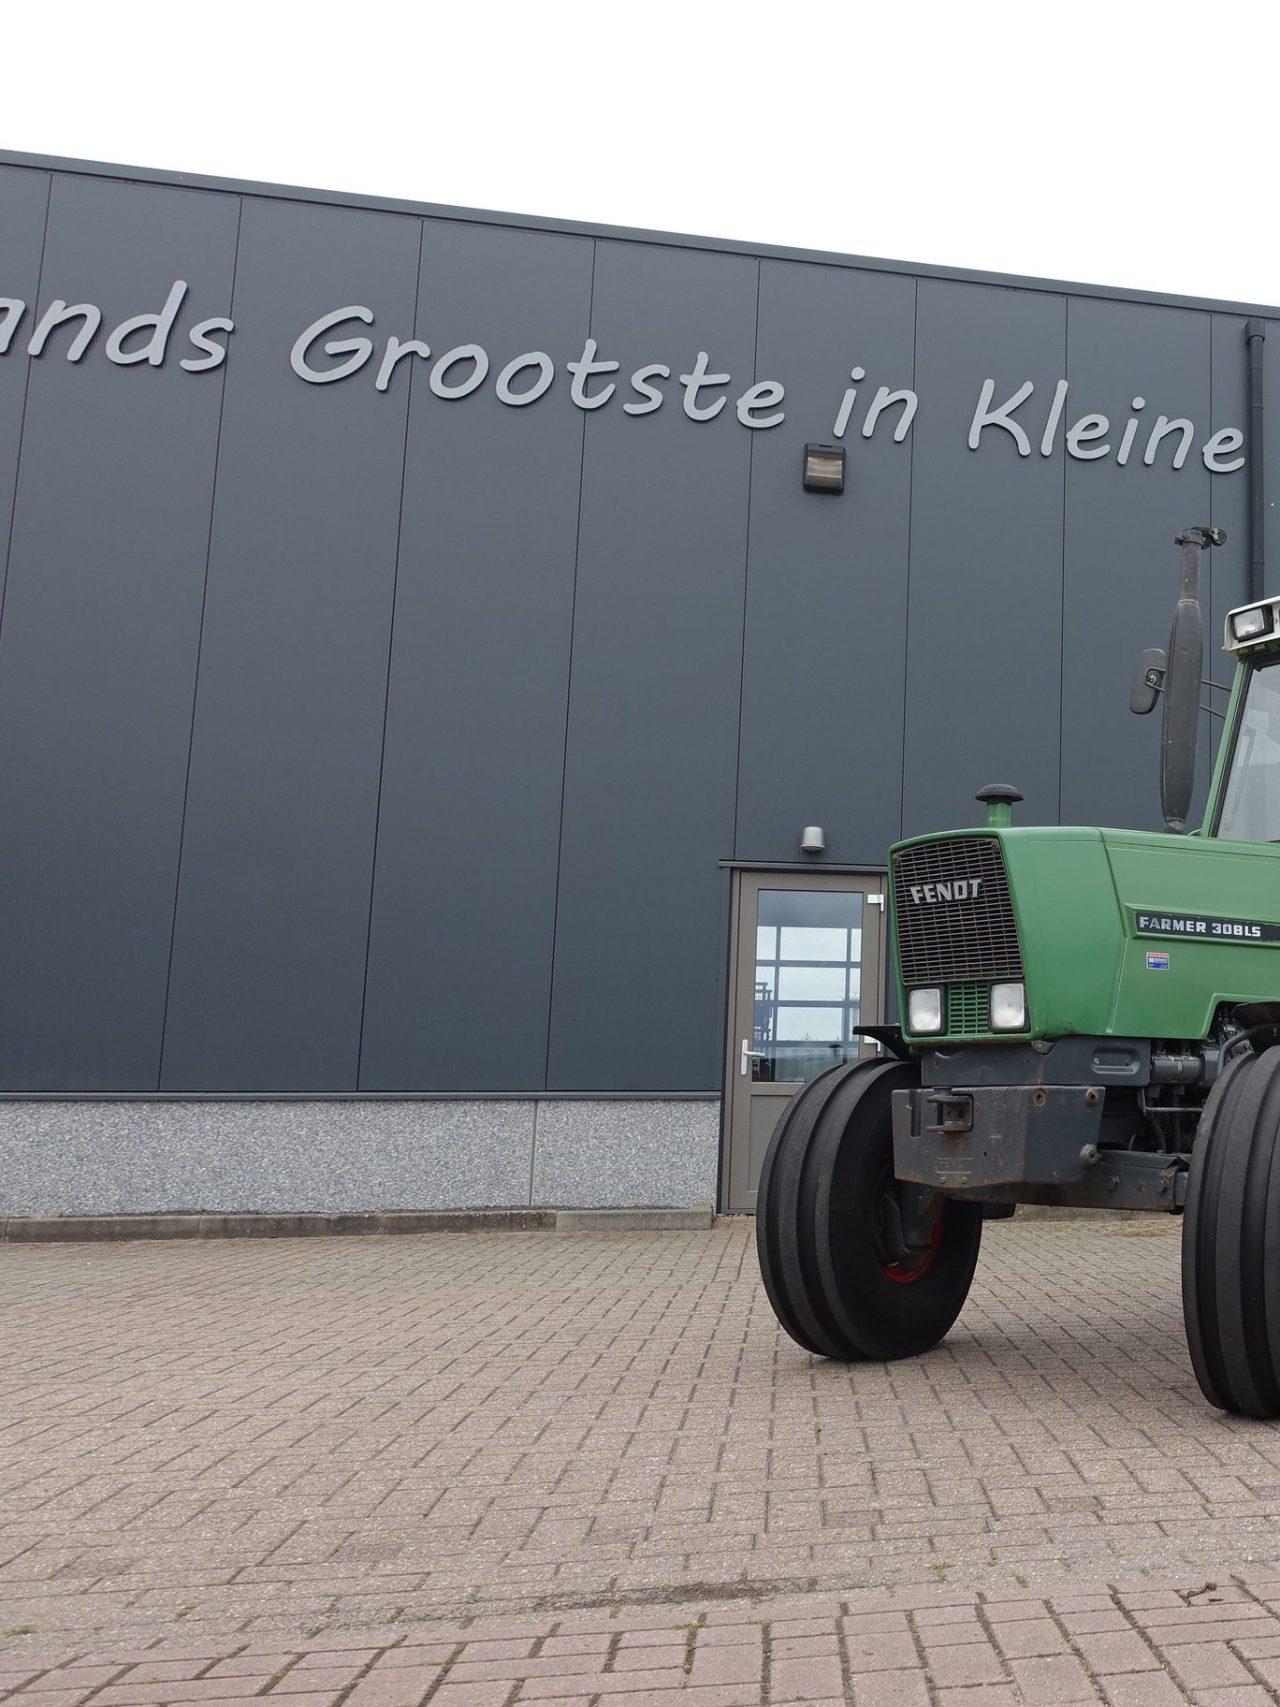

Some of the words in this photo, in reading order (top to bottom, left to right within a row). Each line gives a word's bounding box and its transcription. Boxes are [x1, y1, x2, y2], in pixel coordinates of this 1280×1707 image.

[291, 306, 785, 428] Grootste
[833, 367, 918, 442] in
[968, 379, 1246, 473] Kleine
[910, 879, 982, 904] FENDT
[1139, 916, 1206, 932] FARMER
[1211, 922, 1261, 937] 308LS
